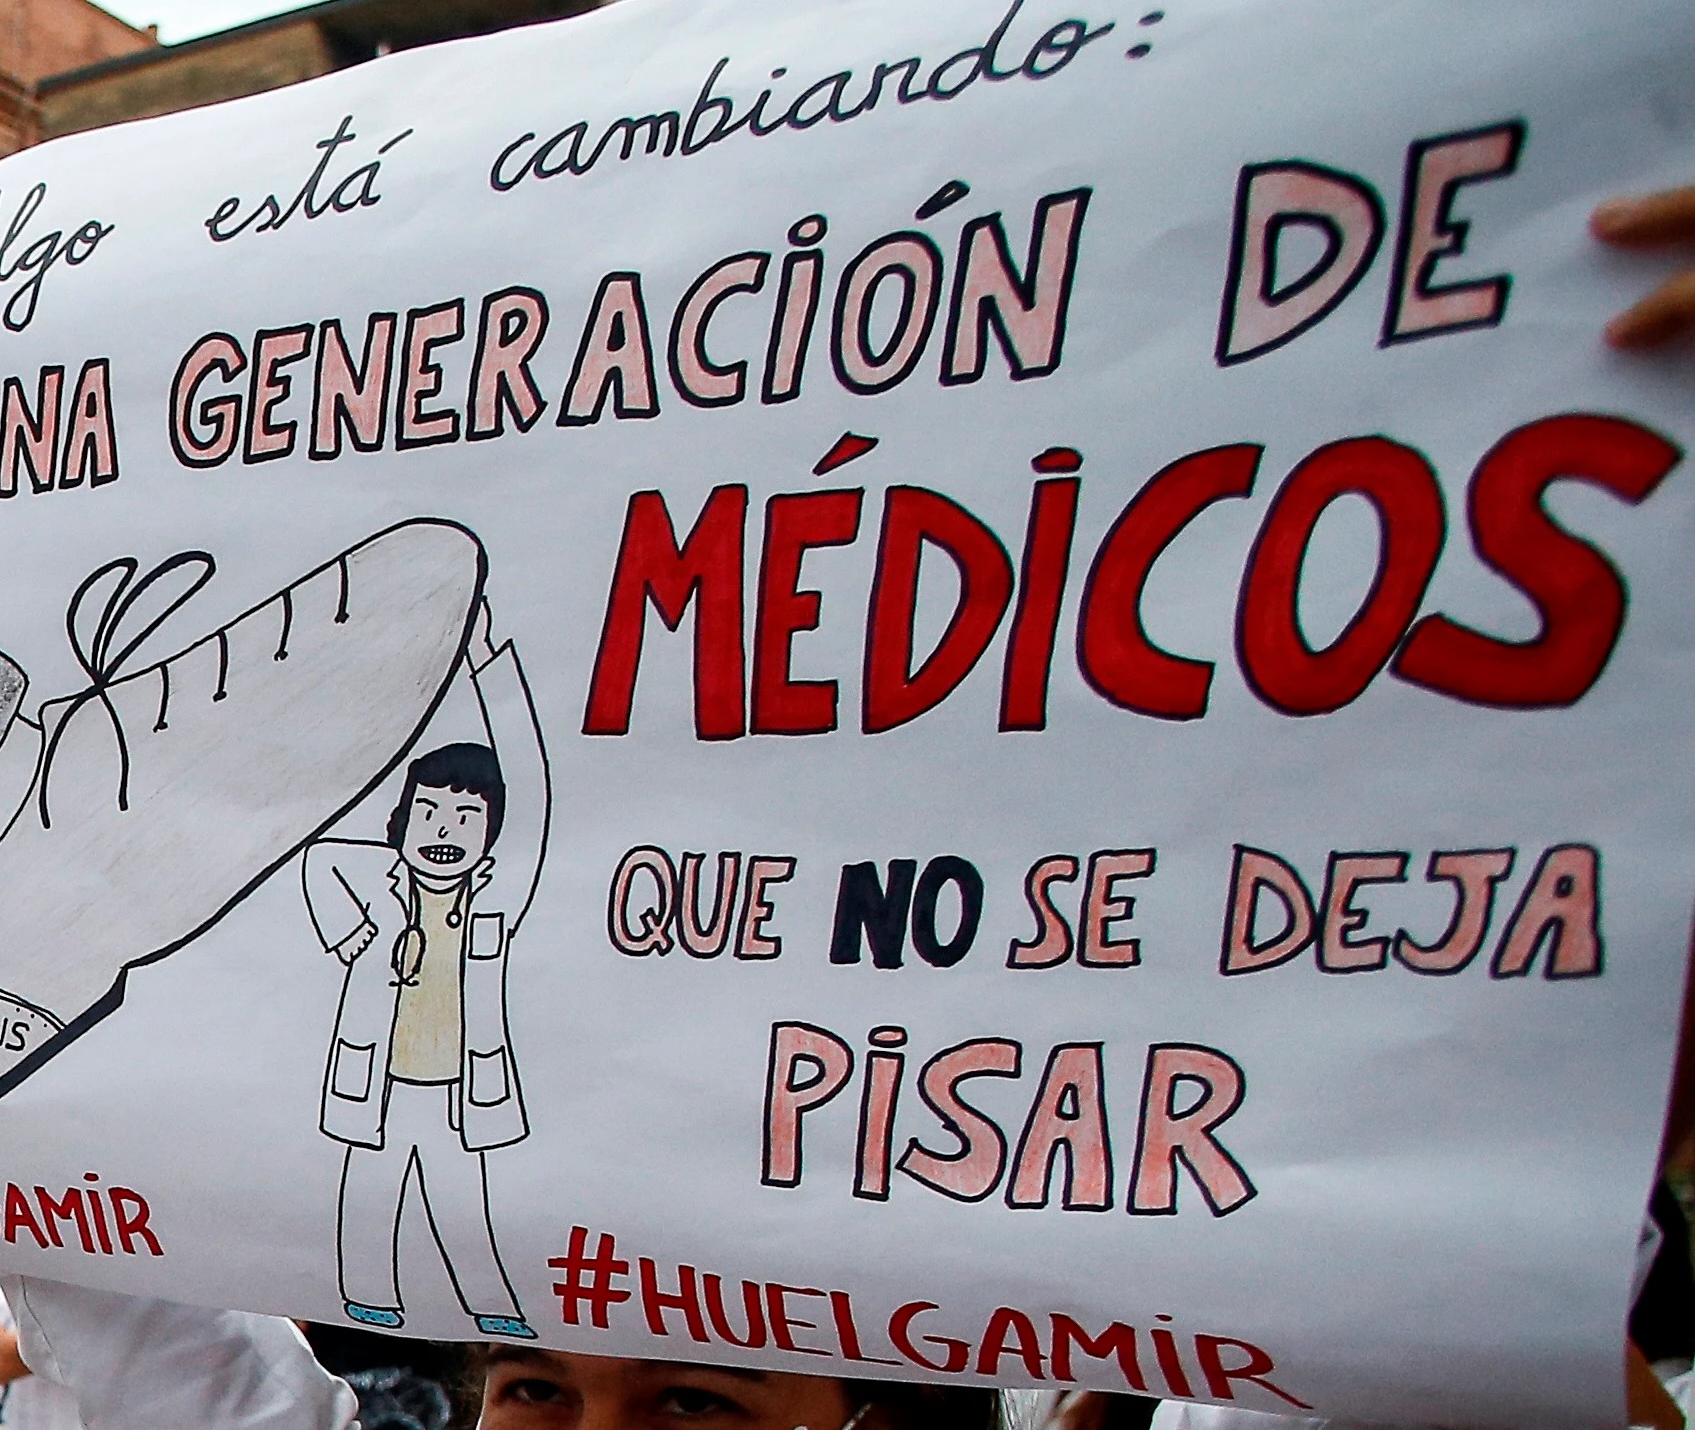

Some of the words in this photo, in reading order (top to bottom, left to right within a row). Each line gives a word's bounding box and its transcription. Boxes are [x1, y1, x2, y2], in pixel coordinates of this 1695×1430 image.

[205, 116, 412, 242] está
[490, 9, 1167, 191] cambiando:
[1215, 120, 1527, 368] DE
[609, 845, 797, 960] QUE
[830, 855, 985, 971] NO
[1008, 848, 1157, 972] SE
[1221, 842, 1606, 980] DEJA
